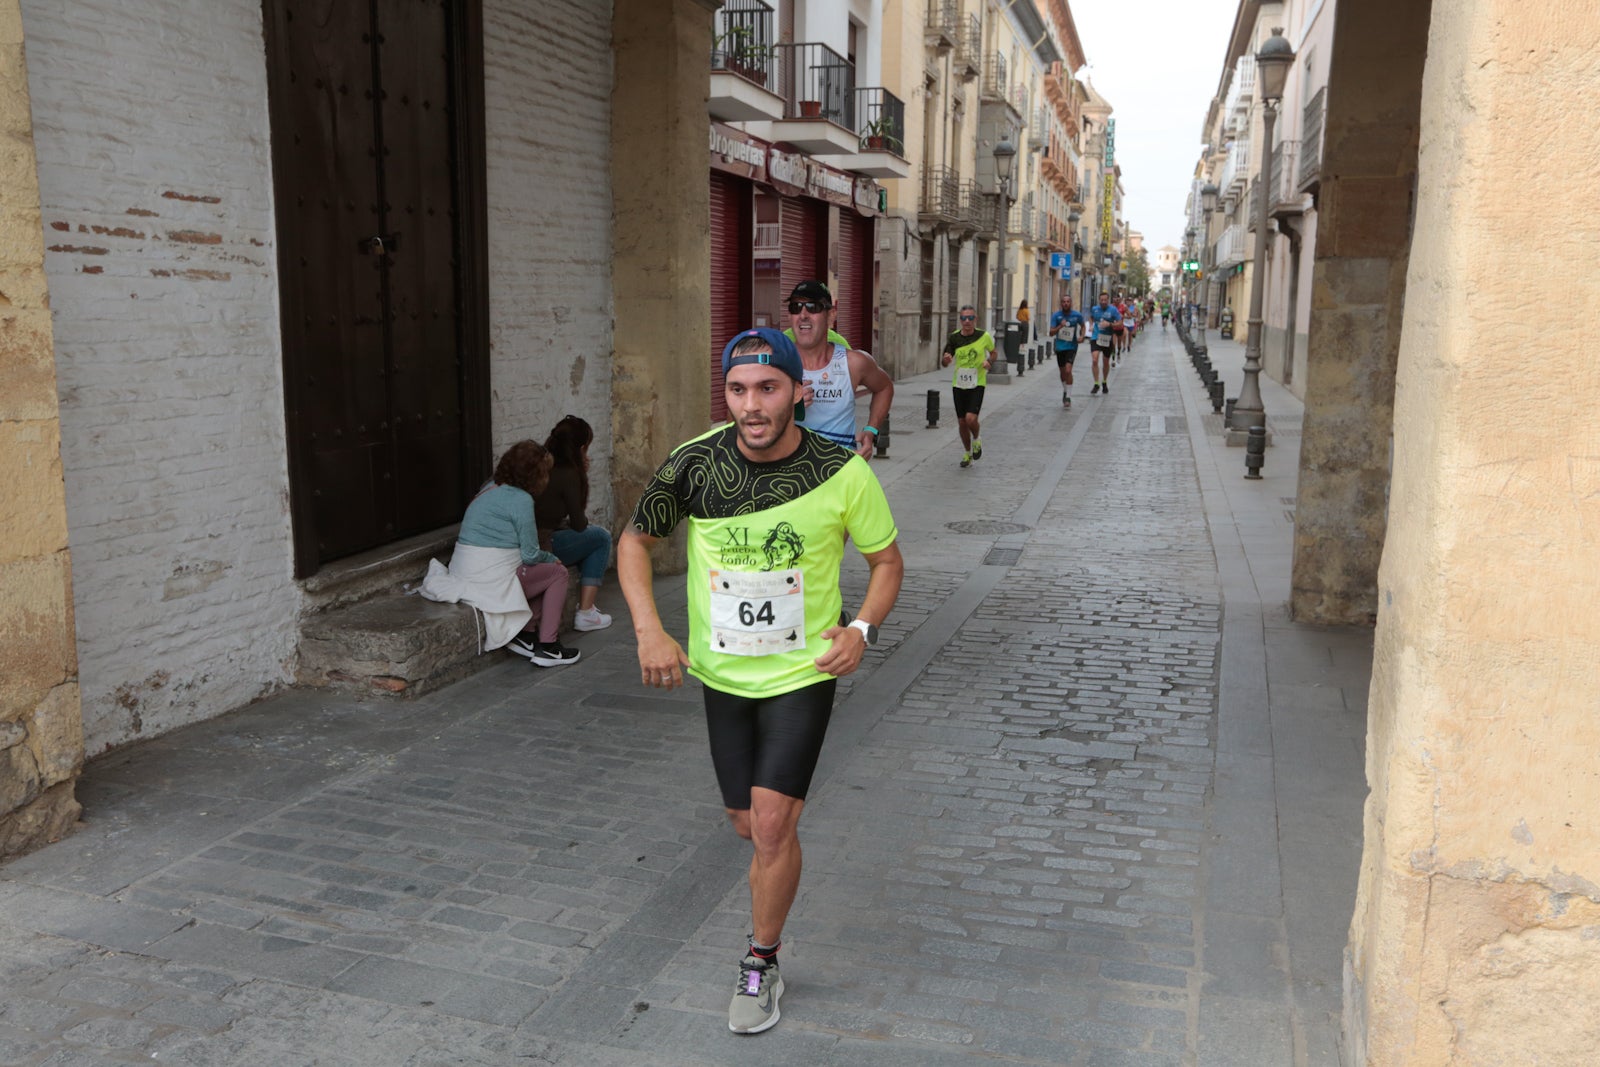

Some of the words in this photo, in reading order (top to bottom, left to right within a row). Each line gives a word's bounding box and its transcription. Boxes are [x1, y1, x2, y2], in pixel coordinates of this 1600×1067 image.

[813, 389, 842, 398] CENA
[724, 527, 750, 546] XI
[720, 554, 757, 566] Fondo
[738, 600, 775, 626] 64
